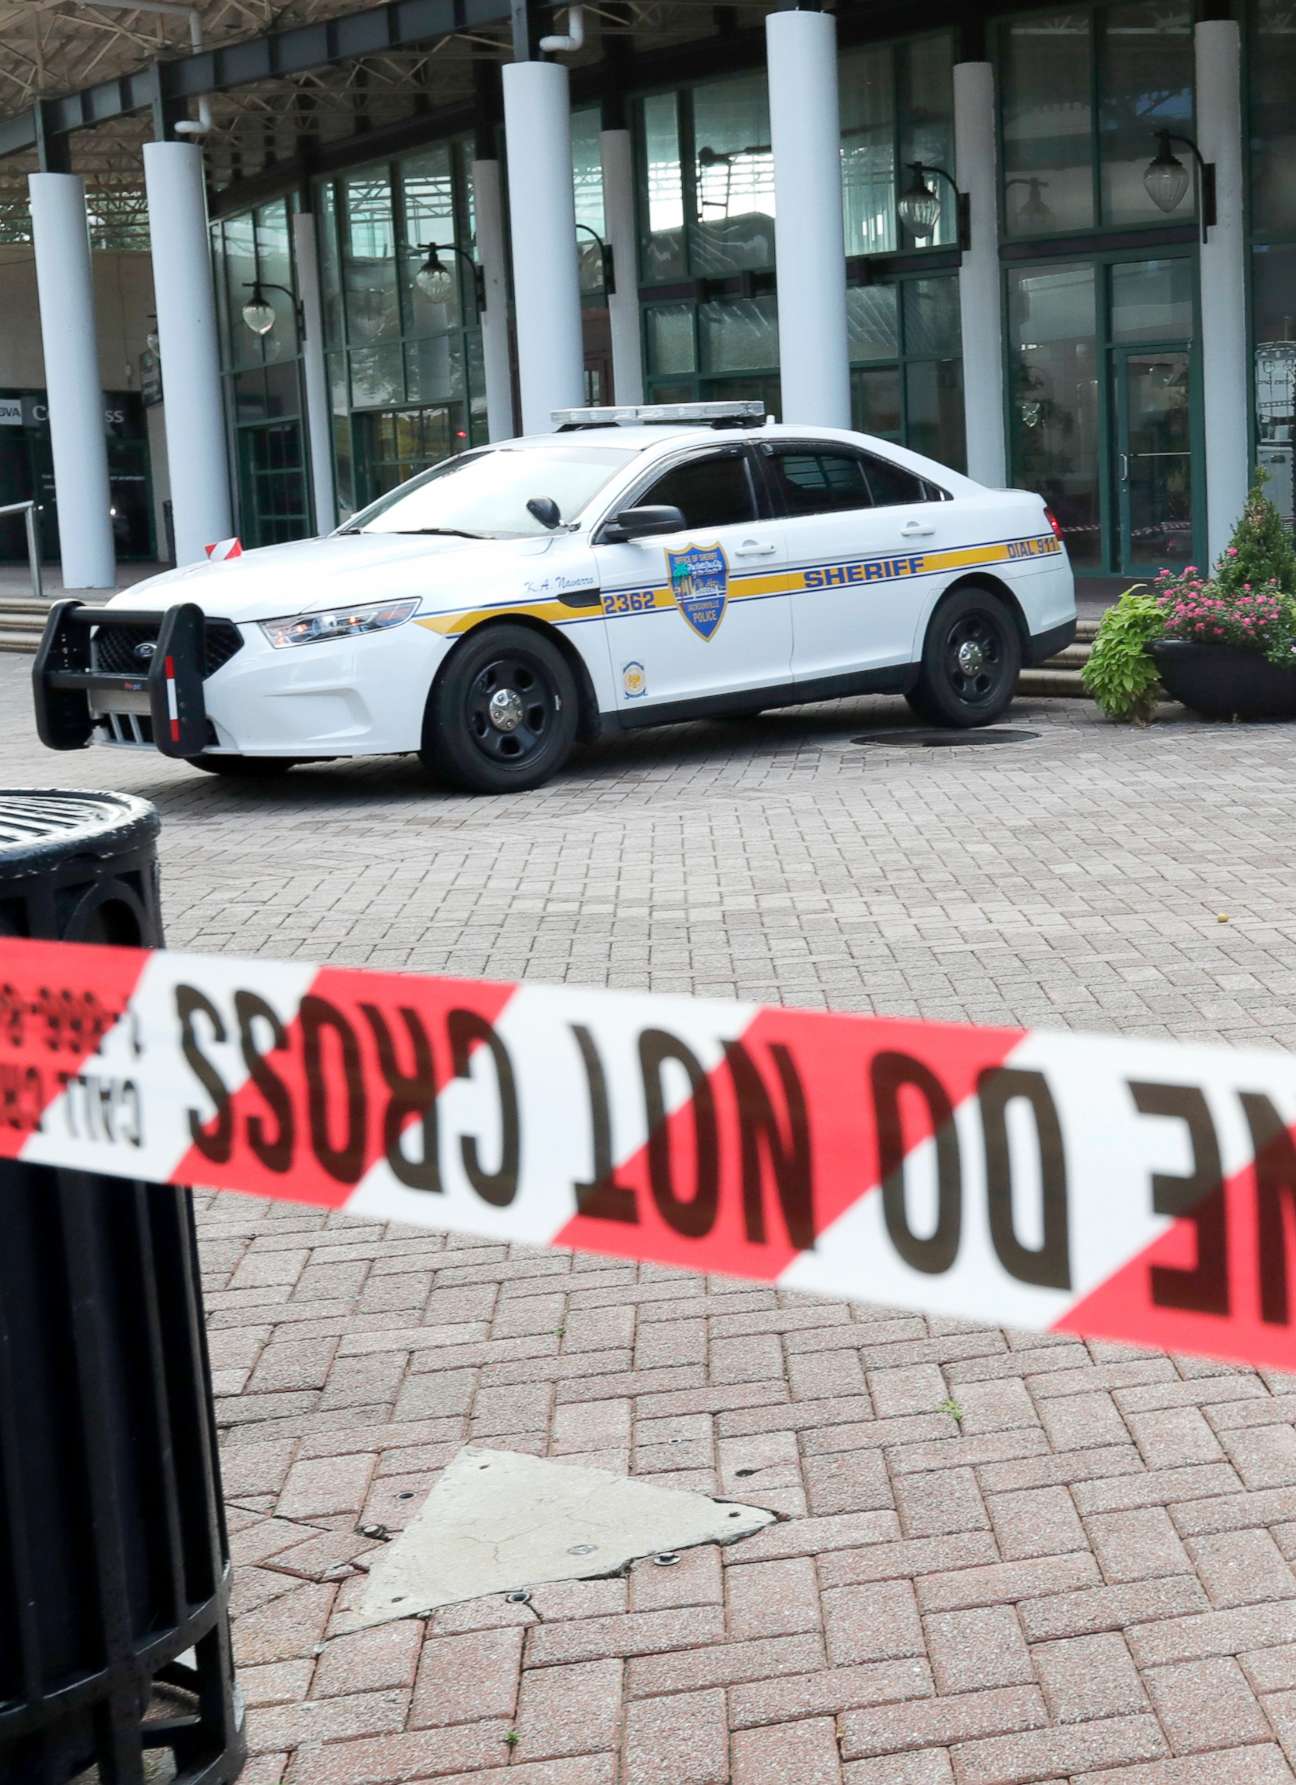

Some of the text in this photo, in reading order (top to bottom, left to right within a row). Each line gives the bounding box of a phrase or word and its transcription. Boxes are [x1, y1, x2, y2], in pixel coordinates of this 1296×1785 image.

[804, 556, 924, 588] SHERIFF
[1008, 536, 1060, 558] DIAL 911
[604, 591, 656, 615] 2362
[57, 1070, 143, 1148] CALL
[173, 982, 520, 1208] CROSS
[567, 1022, 818, 1254] NOT
[868, 1048, 1073, 1293] DO
